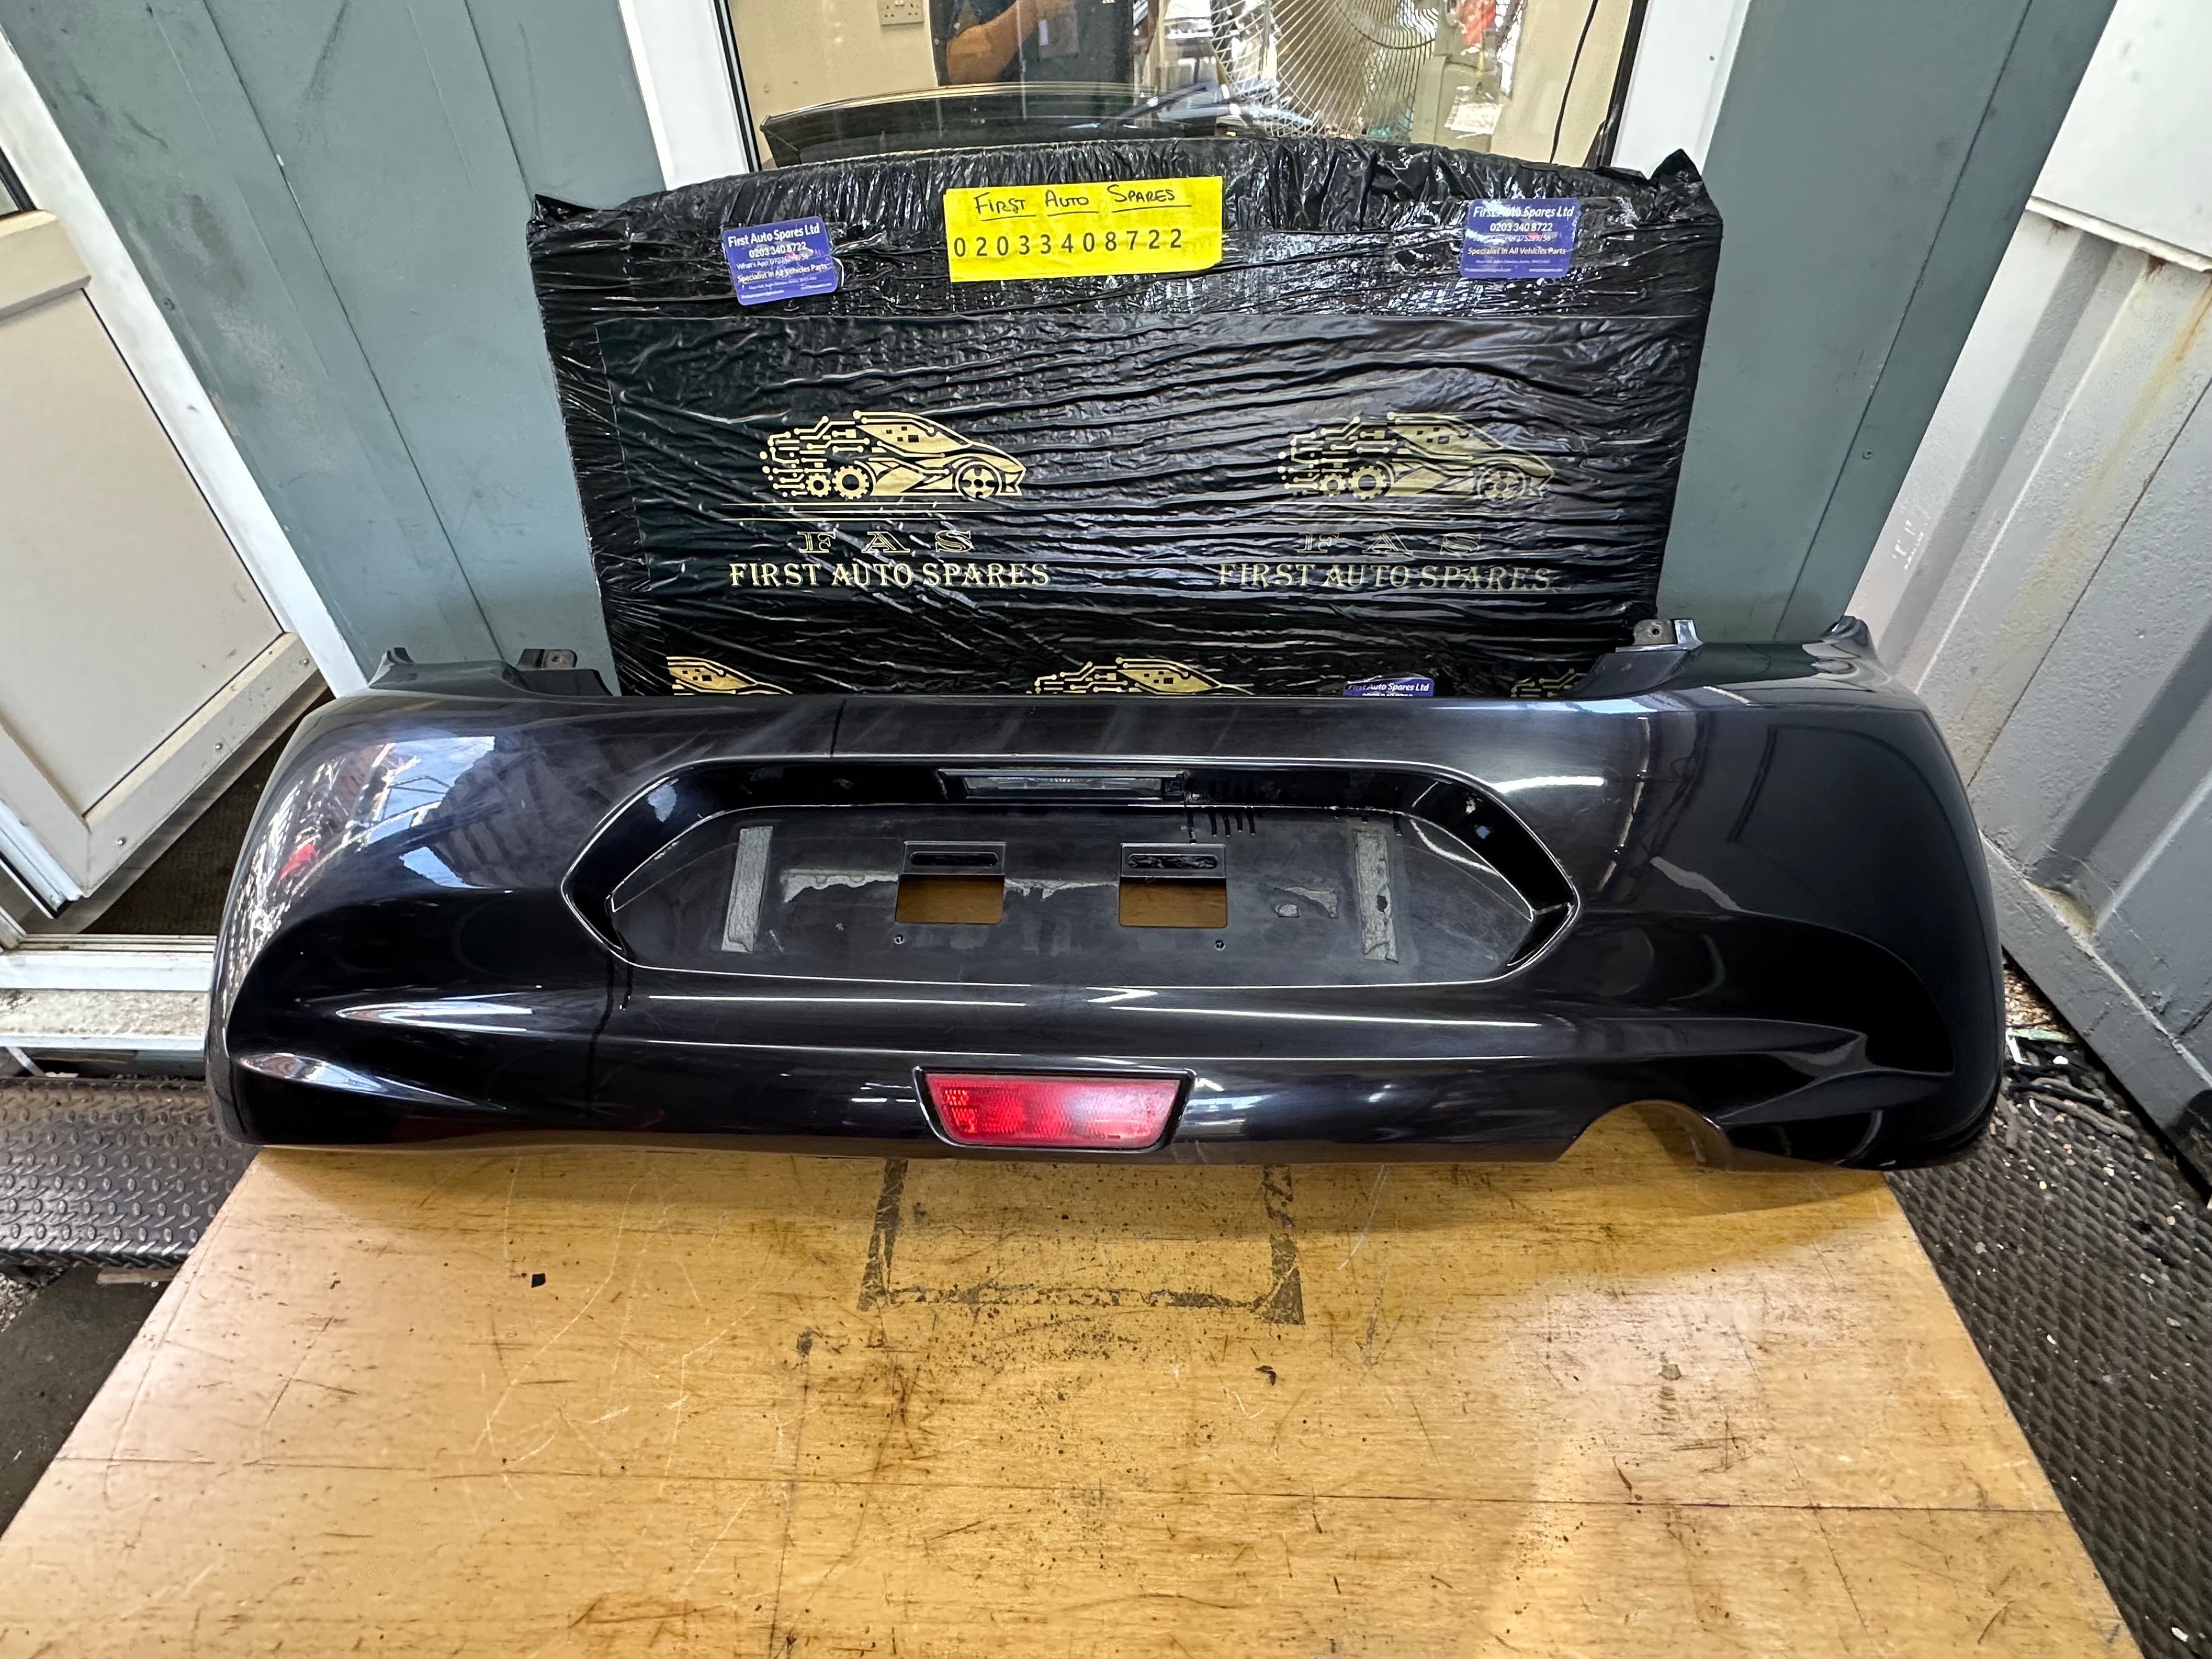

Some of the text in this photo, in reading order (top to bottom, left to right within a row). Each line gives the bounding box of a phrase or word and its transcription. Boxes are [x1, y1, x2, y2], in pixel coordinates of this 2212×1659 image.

[1045, 190, 1090, 208] AUTO
[1107, 185, 1175, 203] SPARES
[1522, 206, 1555, 218] Spares
[1557, 206, 1575, 217] Ltd
[728, 223, 820, 247] First Auto Spares Ltd
[1489, 223, 1553, 232] 0203 340 8722
[748, 241, 808, 258] 0203 340 8722
[737, 271, 767, 283] Specialist
[811, 263, 827, 273] Parts
[729, 563, 1051, 588] FIRST AUTO SPARES
[1218, 563, 1554, 591] FIRST AUTO SPARES
[1387, 682, 1414, 691] Spares
[1415, 683, 1430, 691] Ltd
